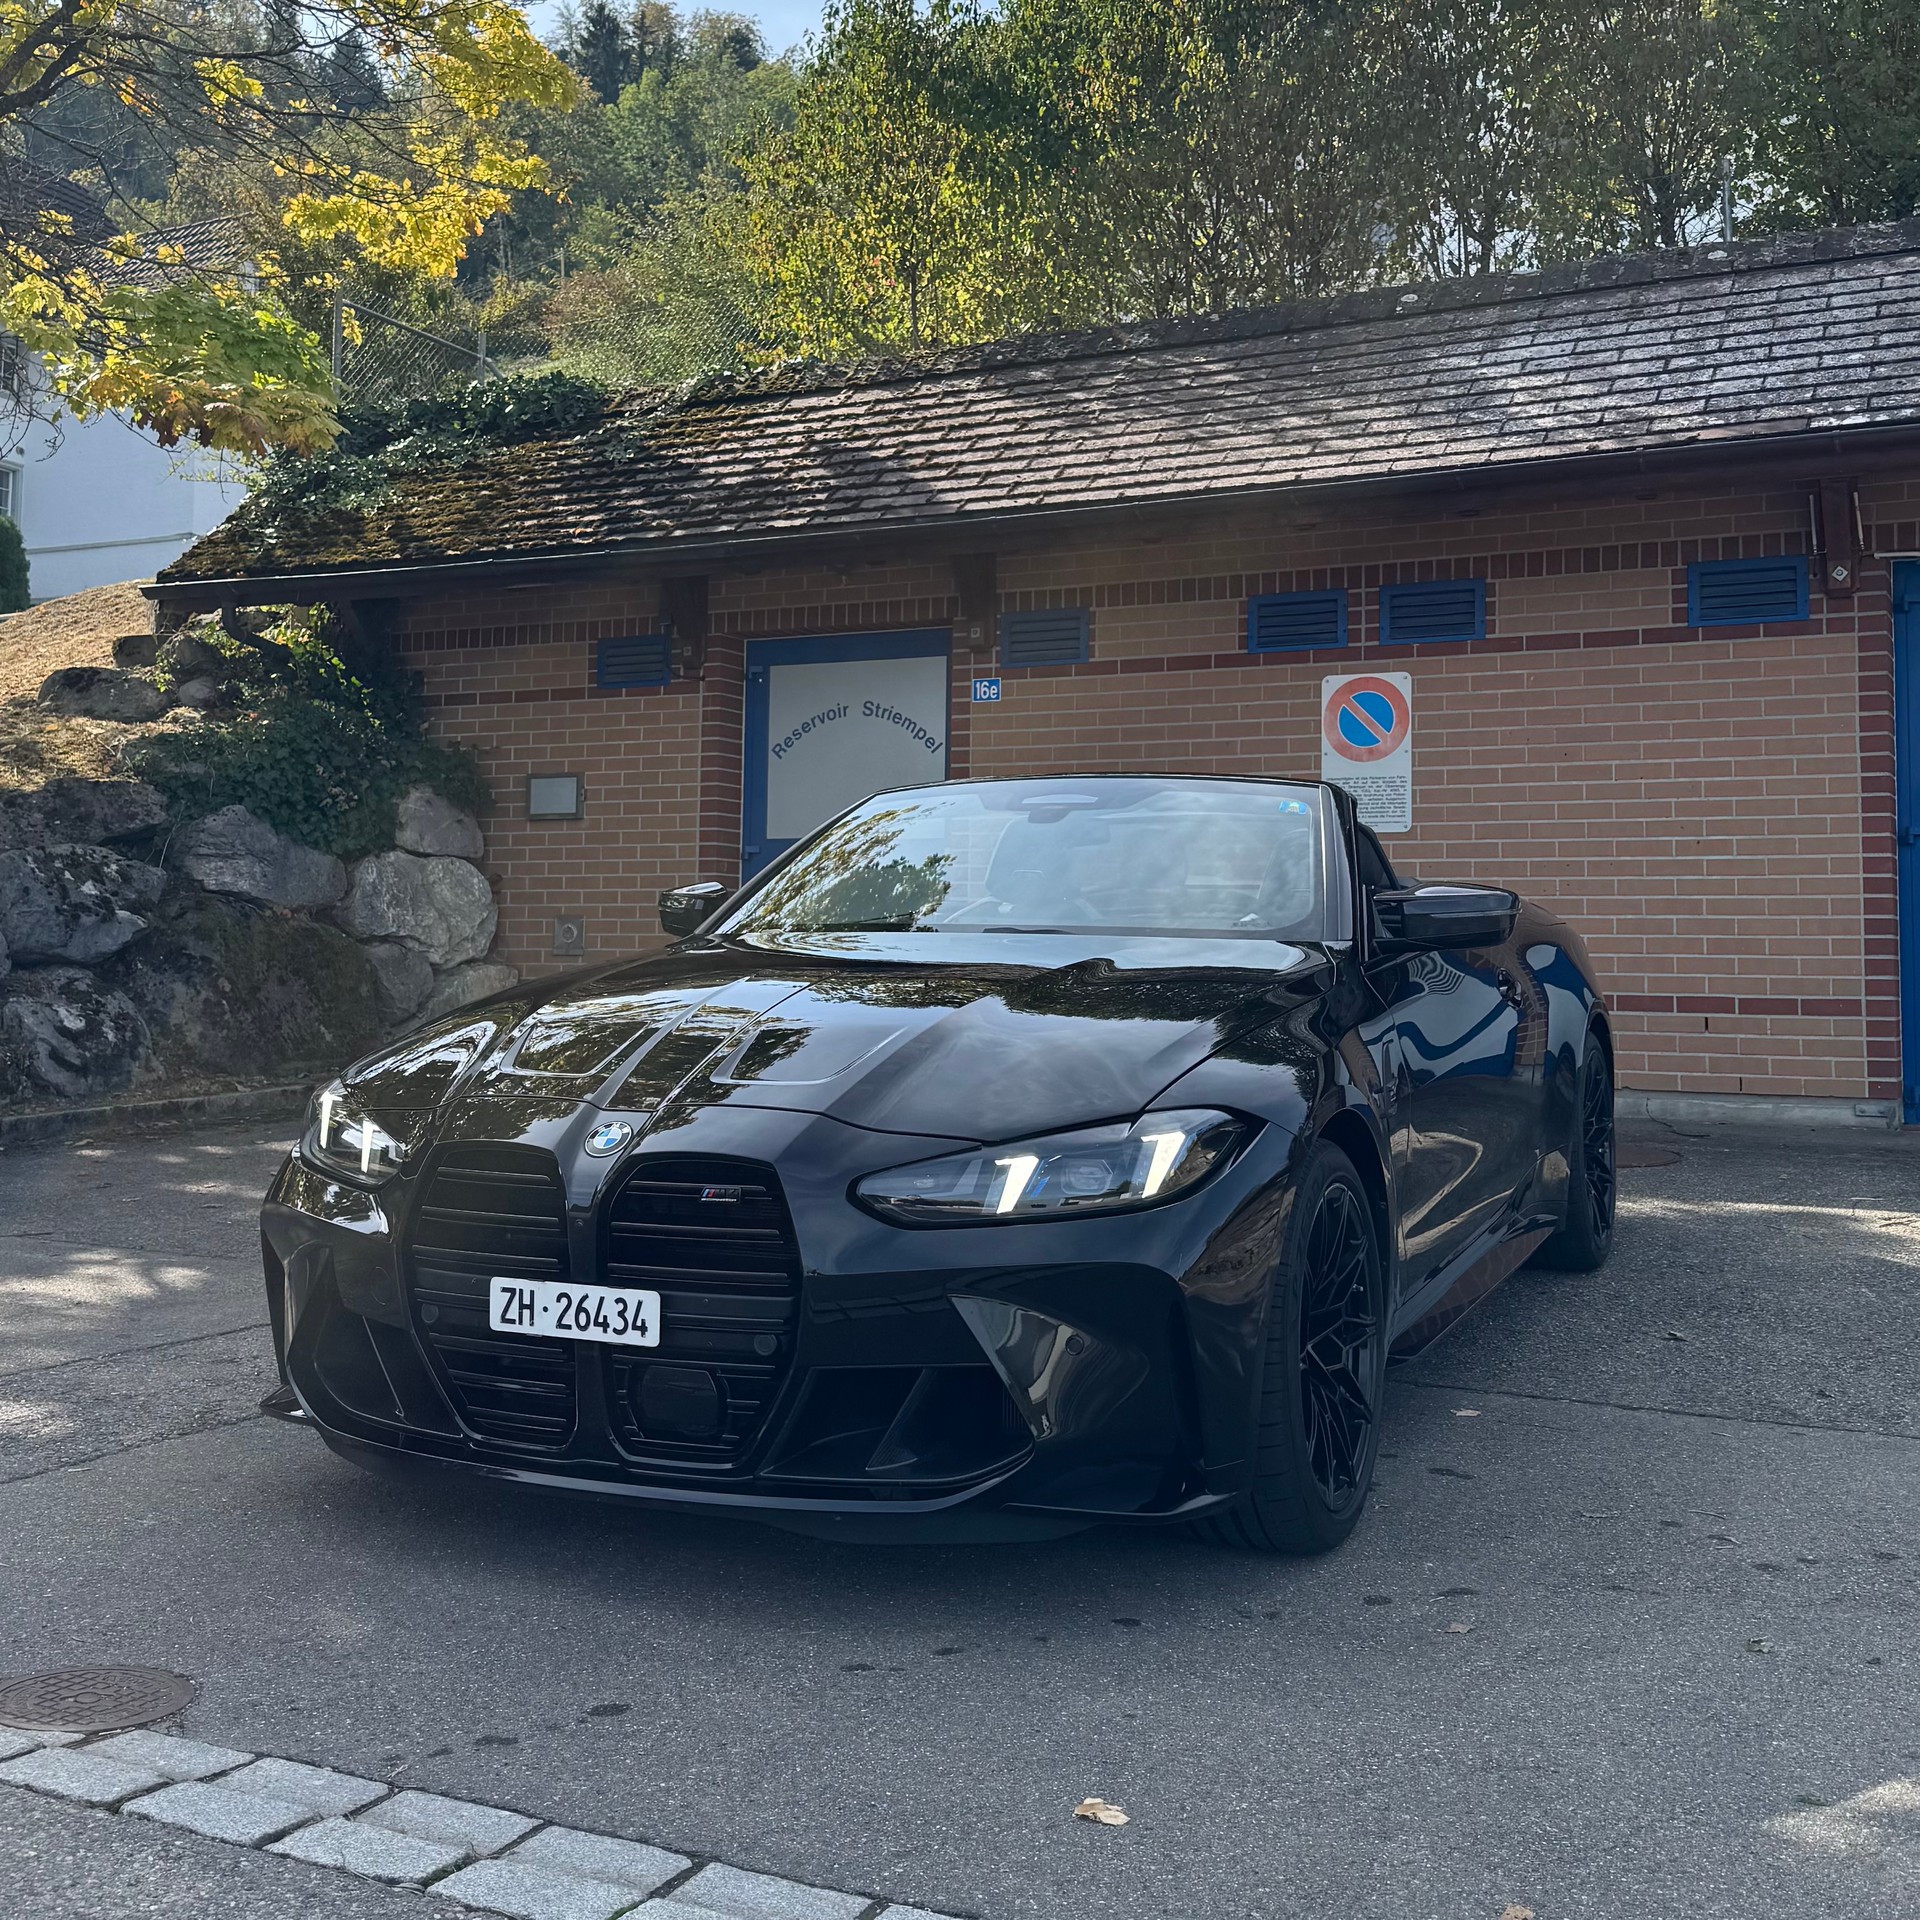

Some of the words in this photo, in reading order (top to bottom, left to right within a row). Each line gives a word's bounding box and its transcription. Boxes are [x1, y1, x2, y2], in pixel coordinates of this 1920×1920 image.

[975, 681, 998, 700] 16e
[771, 703, 849, 760] Reservoir
[862, 700, 943, 754] Striempel
